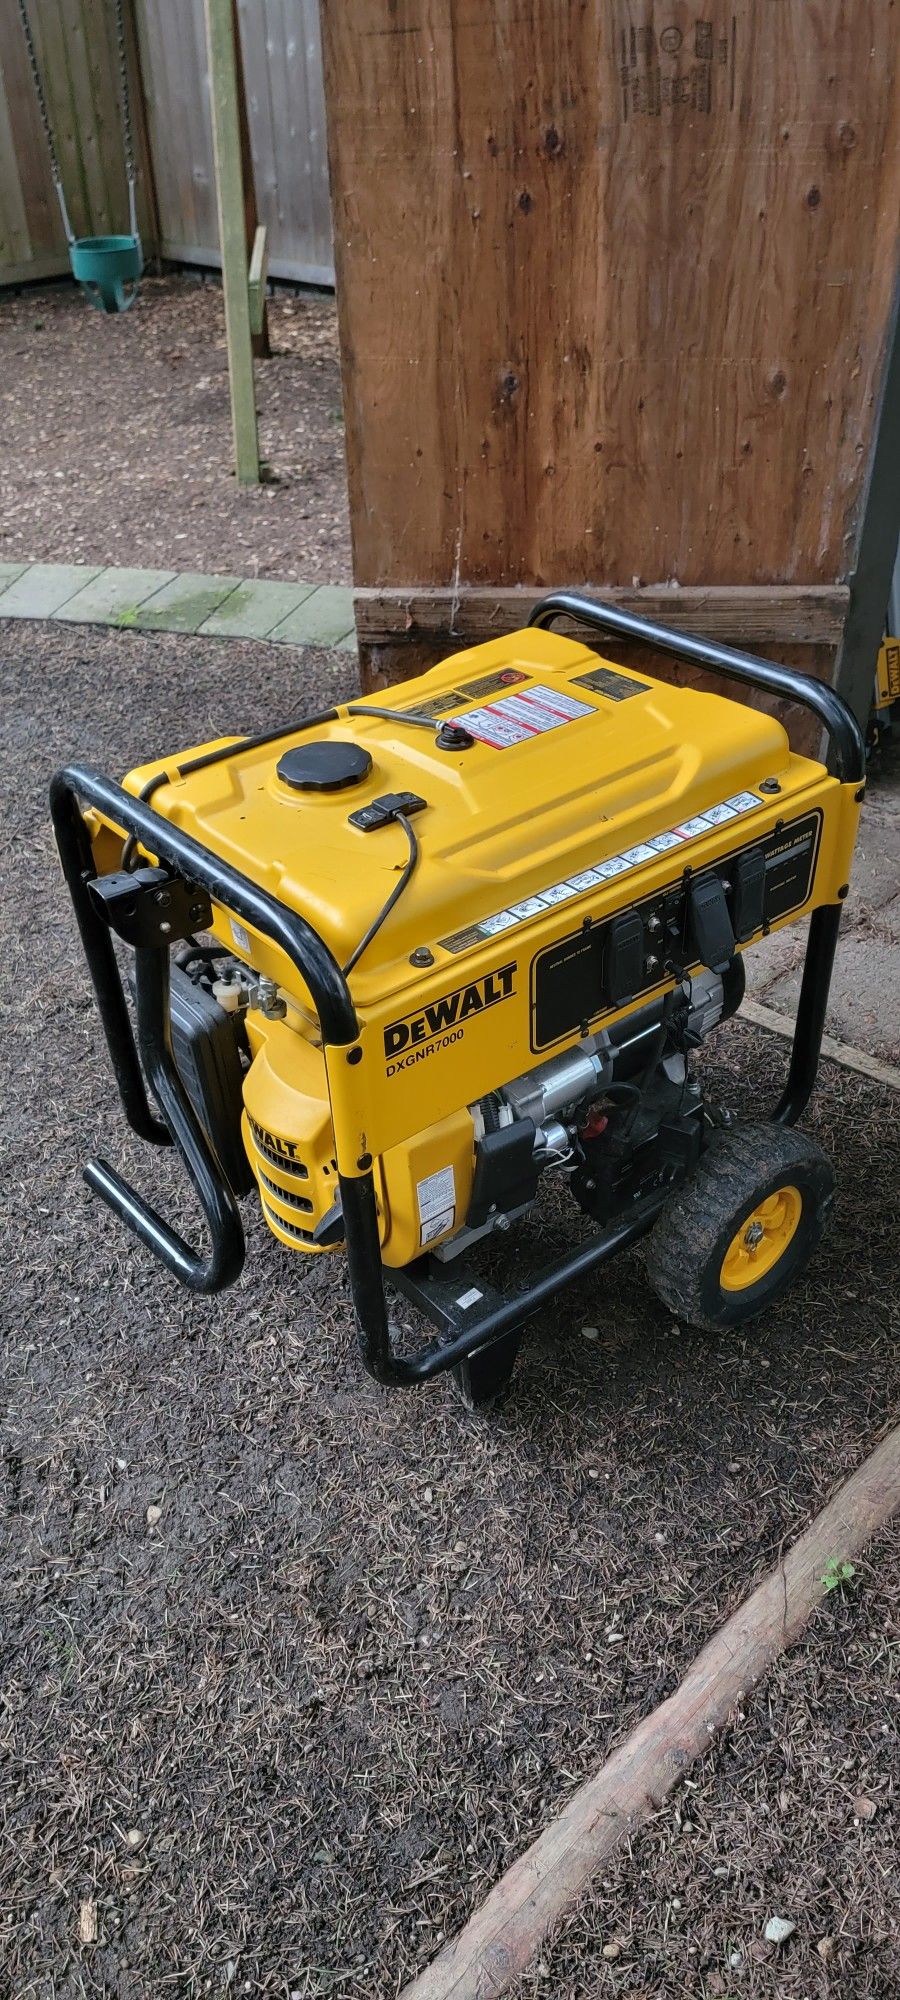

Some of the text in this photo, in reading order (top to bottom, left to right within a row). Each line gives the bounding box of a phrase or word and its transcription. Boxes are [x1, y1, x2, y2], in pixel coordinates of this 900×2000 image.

[764, 830, 813, 859] WATTAGE METER
[384, 963, 517, 1059] DEWALT
[385, 1028, 465, 1078] DXGNR7000
